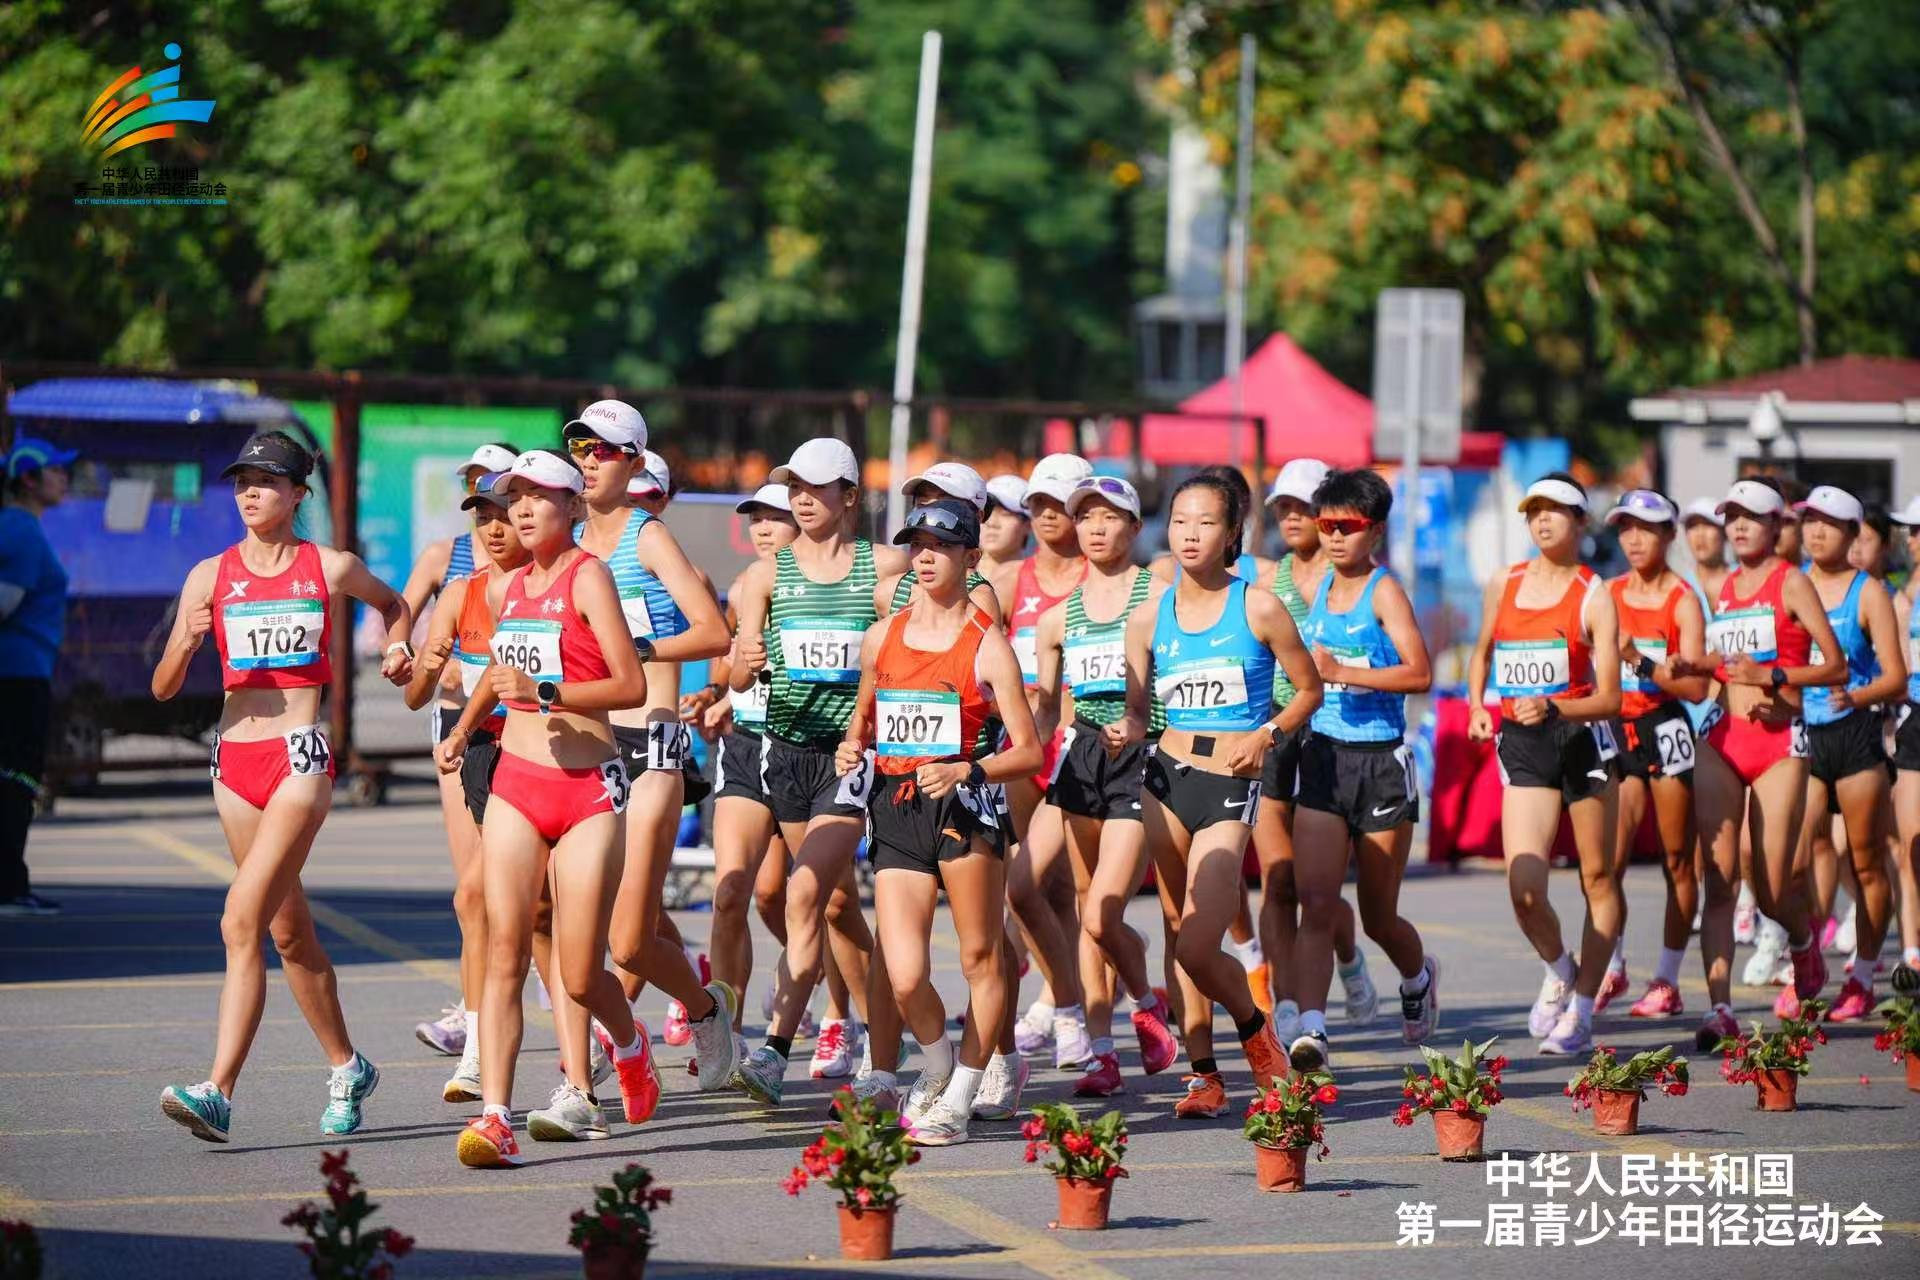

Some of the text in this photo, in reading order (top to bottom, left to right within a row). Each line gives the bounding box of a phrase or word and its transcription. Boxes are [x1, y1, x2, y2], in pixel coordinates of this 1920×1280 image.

[585, 408, 617, 421] CHINA
[289, 579, 318, 596] 青海
[248, 625, 308, 656] 1702
[1720, 628, 1760, 653] 1704
[498, 645, 541, 674] 1696
[799, 642, 849, 668] 1551
[1081, 654, 1126, 681] 1573
[1504, 662, 1555, 685] 2000
[751, 687, 771, 706] 15
[1176, 680, 1227, 707] 1772
[886, 714, 944, 743] 2007
[290, 729, 329, 773] 34
[1660, 728, 1692, 766] 26
